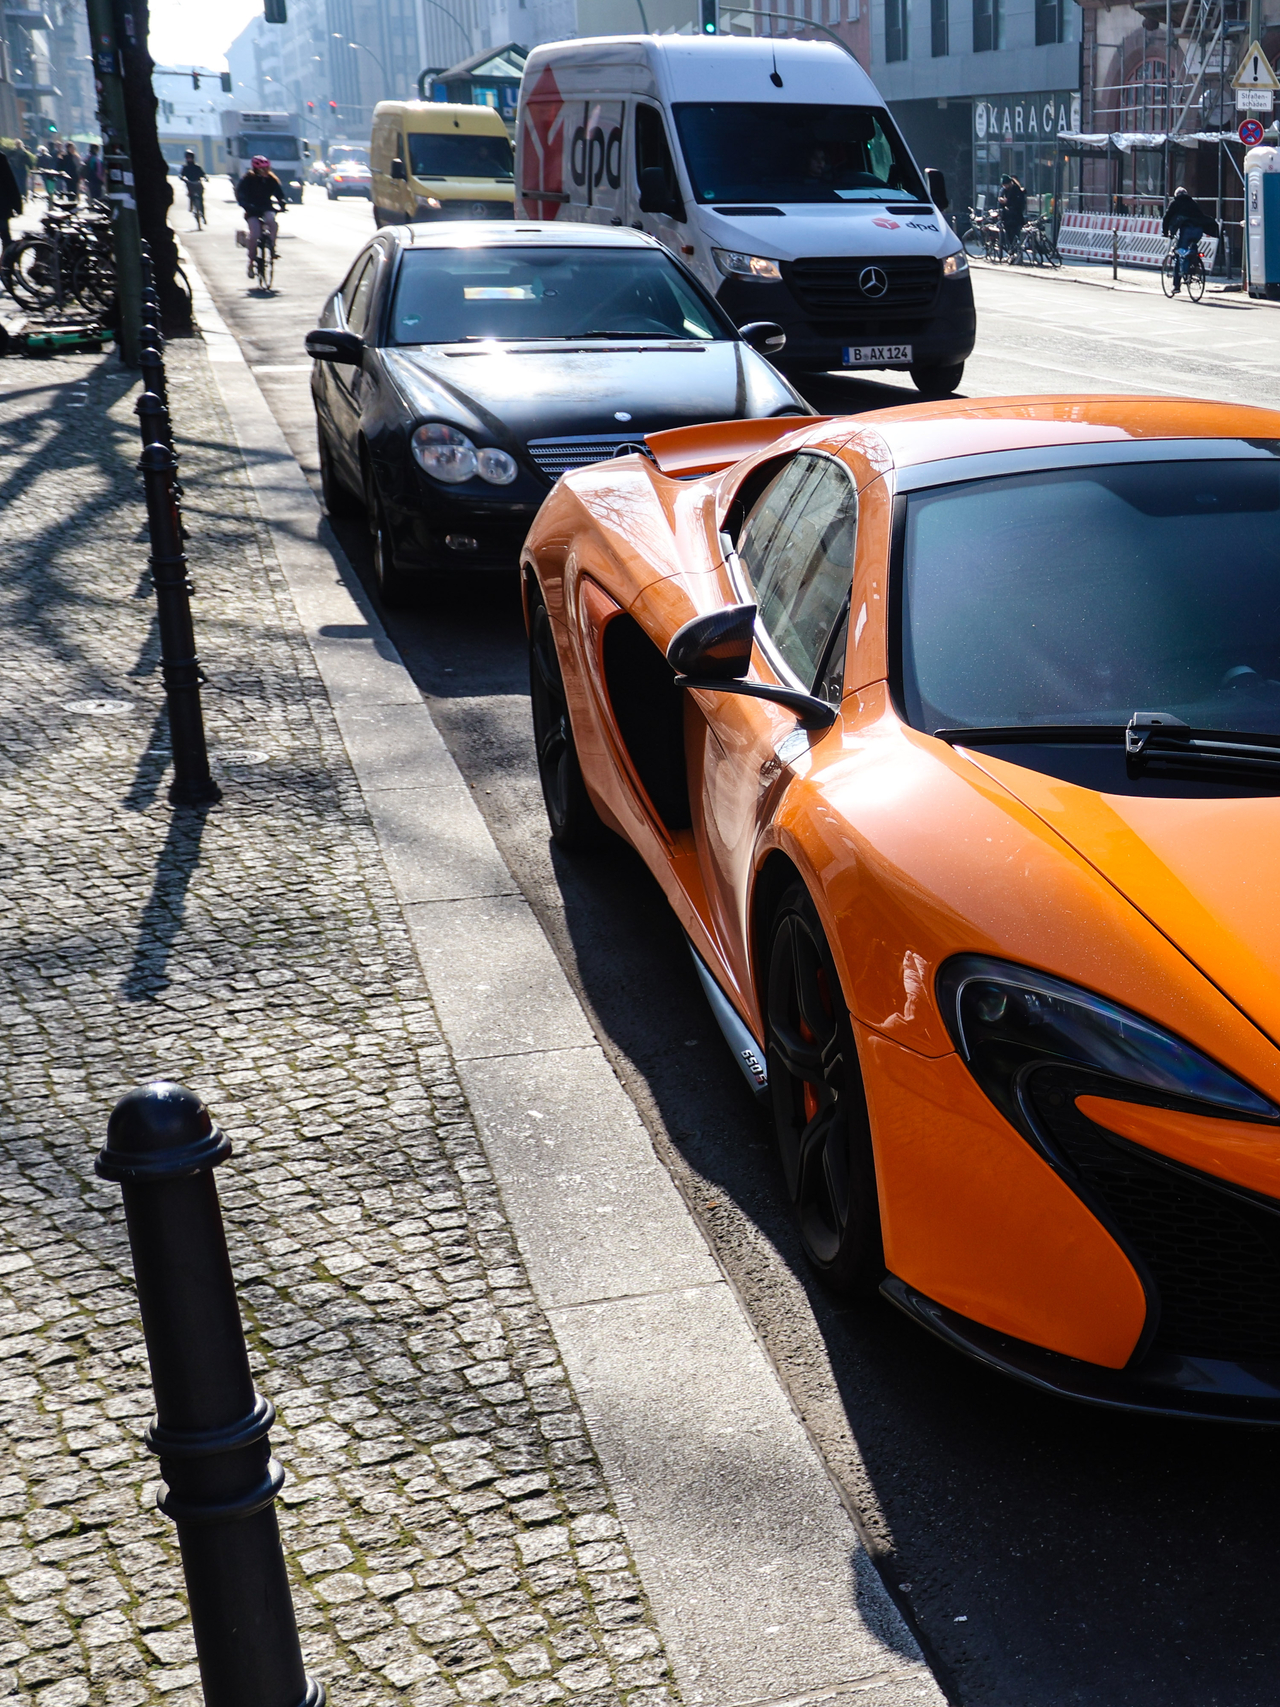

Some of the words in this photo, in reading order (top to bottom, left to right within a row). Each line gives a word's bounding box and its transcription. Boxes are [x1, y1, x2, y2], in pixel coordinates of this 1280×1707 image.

[989, 104, 1067, 134] KARACA
[571, 101, 625, 207] dpd
[905, 221, 939, 232] dpd
[854, 349, 862, 360] B
[870, 348, 885, 360] AX
[887, 347, 907, 359] 124
[741, 1049, 767, 1083] 650S
